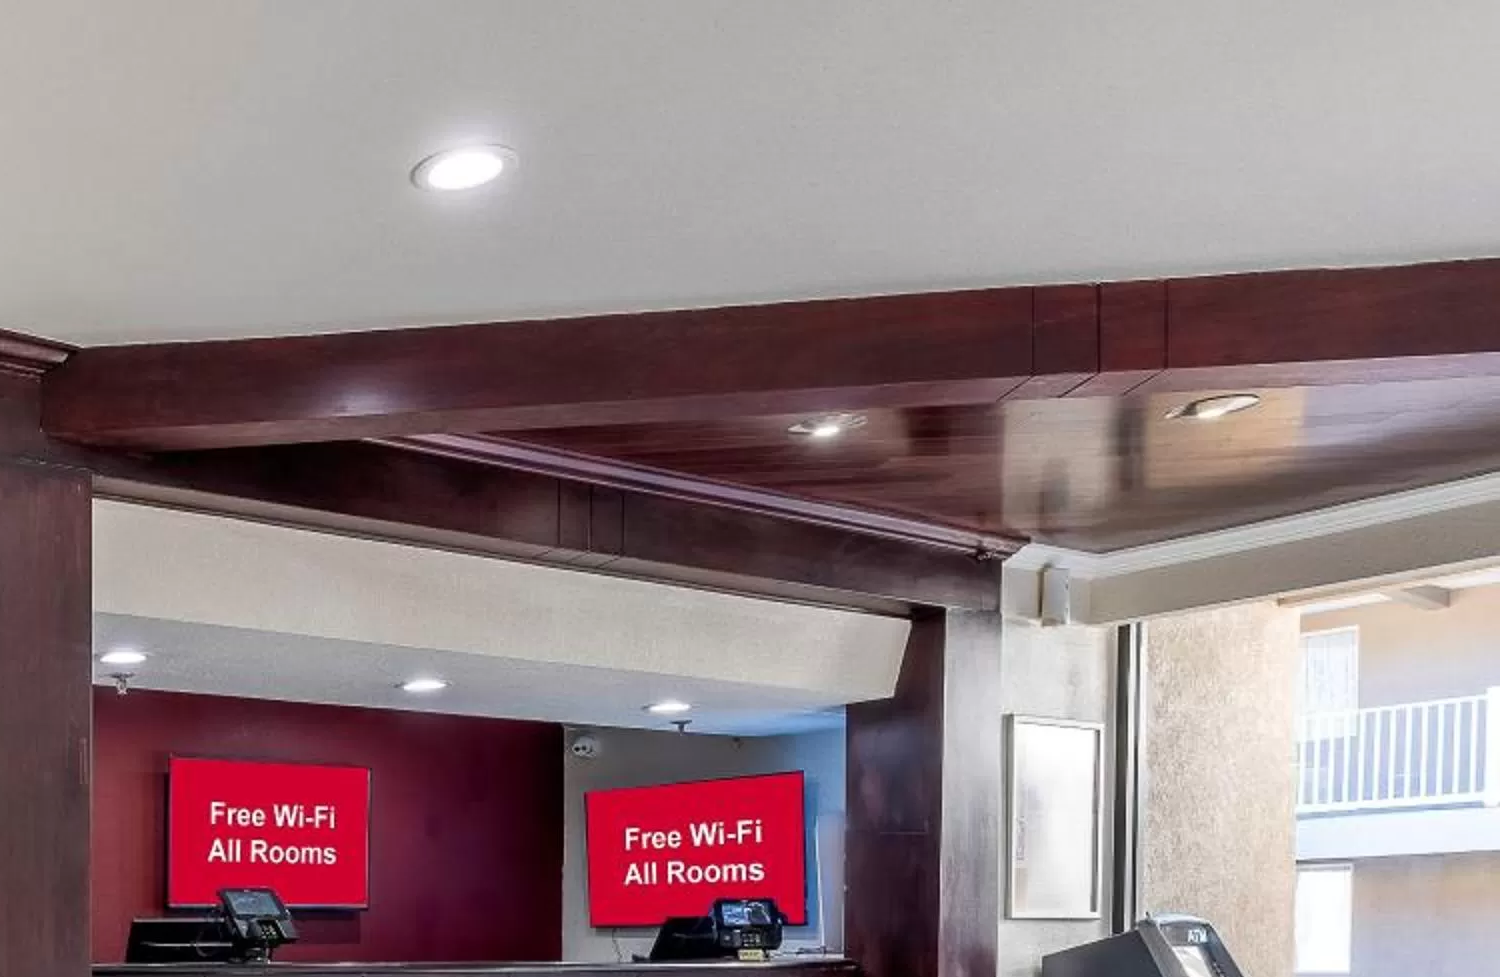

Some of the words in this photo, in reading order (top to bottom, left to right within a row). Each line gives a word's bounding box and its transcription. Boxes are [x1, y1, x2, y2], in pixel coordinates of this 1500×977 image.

[210, 801, 266, 827] Free
[273, 803, 335, 829] Wi-Fi
[625, 827, 682, 850] Free
[689, 819, 763, 847] Wi-Fi
[207, 837, 241, 863] All
[250, 839, 337, 865] Rooms
[624, 861, 657, 886] All
[667, 860, 765, 884] Rooms
[1187, 929, 1208, 943] ATM
